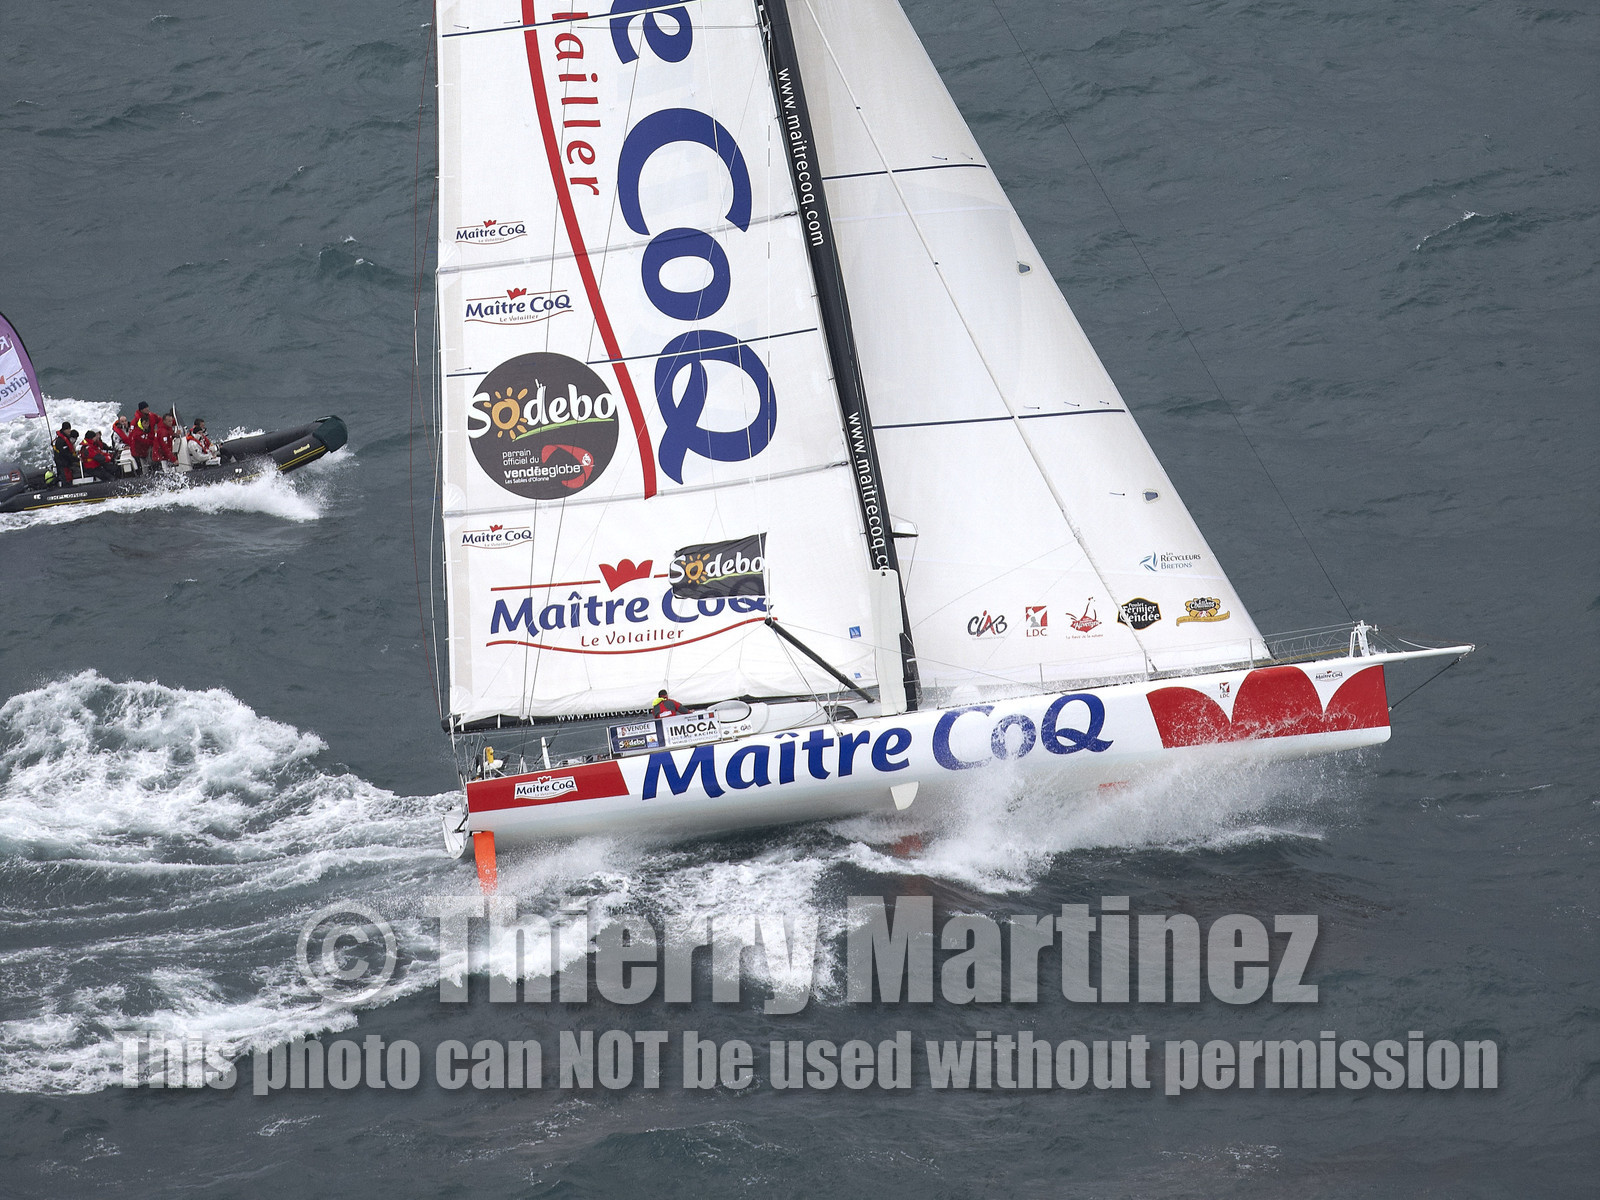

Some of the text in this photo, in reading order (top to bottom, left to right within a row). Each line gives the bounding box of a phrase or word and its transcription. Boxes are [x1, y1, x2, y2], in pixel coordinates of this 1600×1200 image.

[778, 67, 825, 247] www.maitrecoq.com
[456, 228, 496, 240] Maître
[498, 224, 526, 237] CoQ
[617, 108, 777, 485] CoQ
[465, 294, 572, 318] Maître CoQ
[467, 380, 617, 439] Sodebo
[502, 449, 532, 459] parrain
[503, 456, 540, 466] officiel du
[462, 529, 533, 544] Maître CoQ
[1160, 554, 1201, 562] RECYCLEURS
[668, 551, 765, 584] Sodebo
[1161, 562, 1193, 570] BRETONS
[490, 591, 650, 638] Maître
[581, 627, 685, 647] Le Volailler
[1026, 628, 1048, 637] LDC
[669, 721, 717, 736] IMOCA
[619, 737, 646, 748] Sodebo
[642, 692, 1114, 800] Maître CoQ
[552, 780, 575, 791] CoQ
